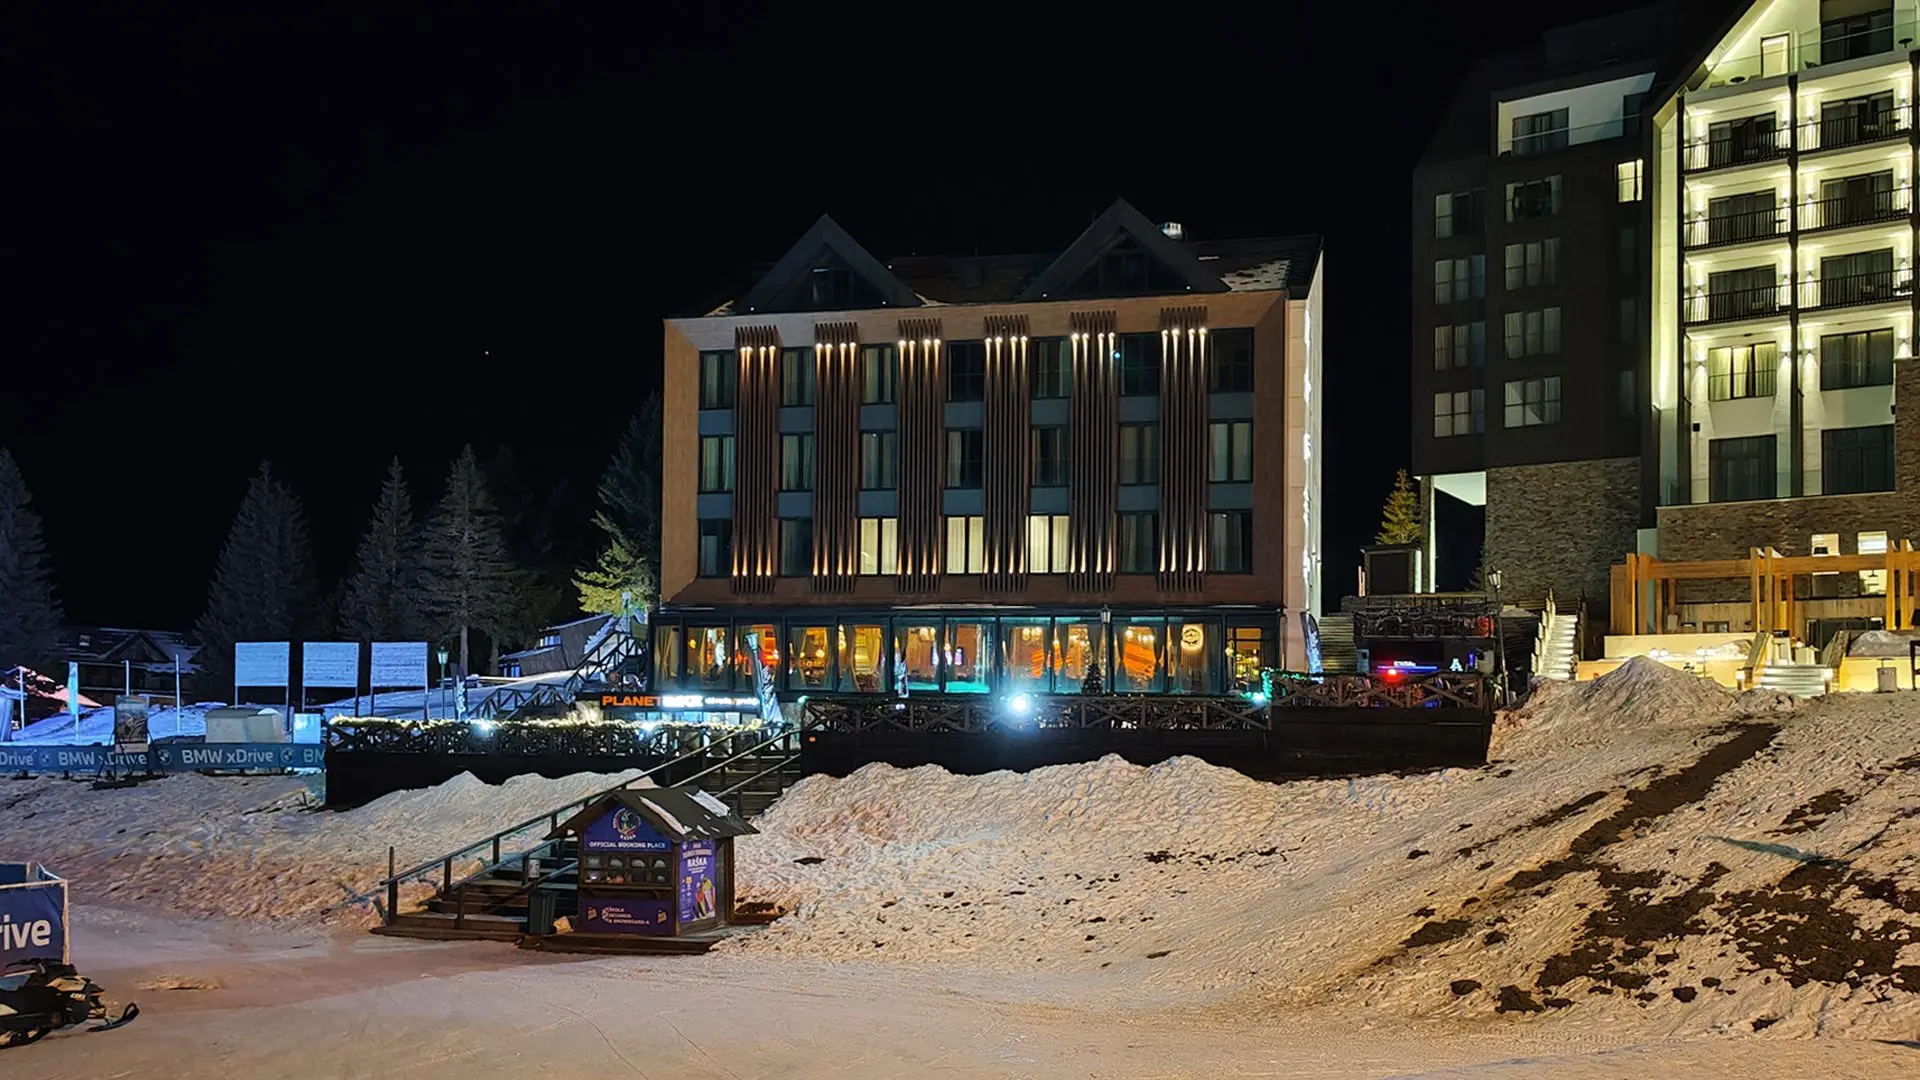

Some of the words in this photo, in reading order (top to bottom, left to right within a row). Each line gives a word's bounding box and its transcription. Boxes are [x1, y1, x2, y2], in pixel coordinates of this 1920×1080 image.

[602, 695, 662, 707] PLANET
[58, 751, 95, 766] BMW
[181, 749, 222, 764] BMW
[226, 749, 274, 763] xDrive
[618, 841, 647, 849] BOOKING
[0, 914, 50, 950] ive
